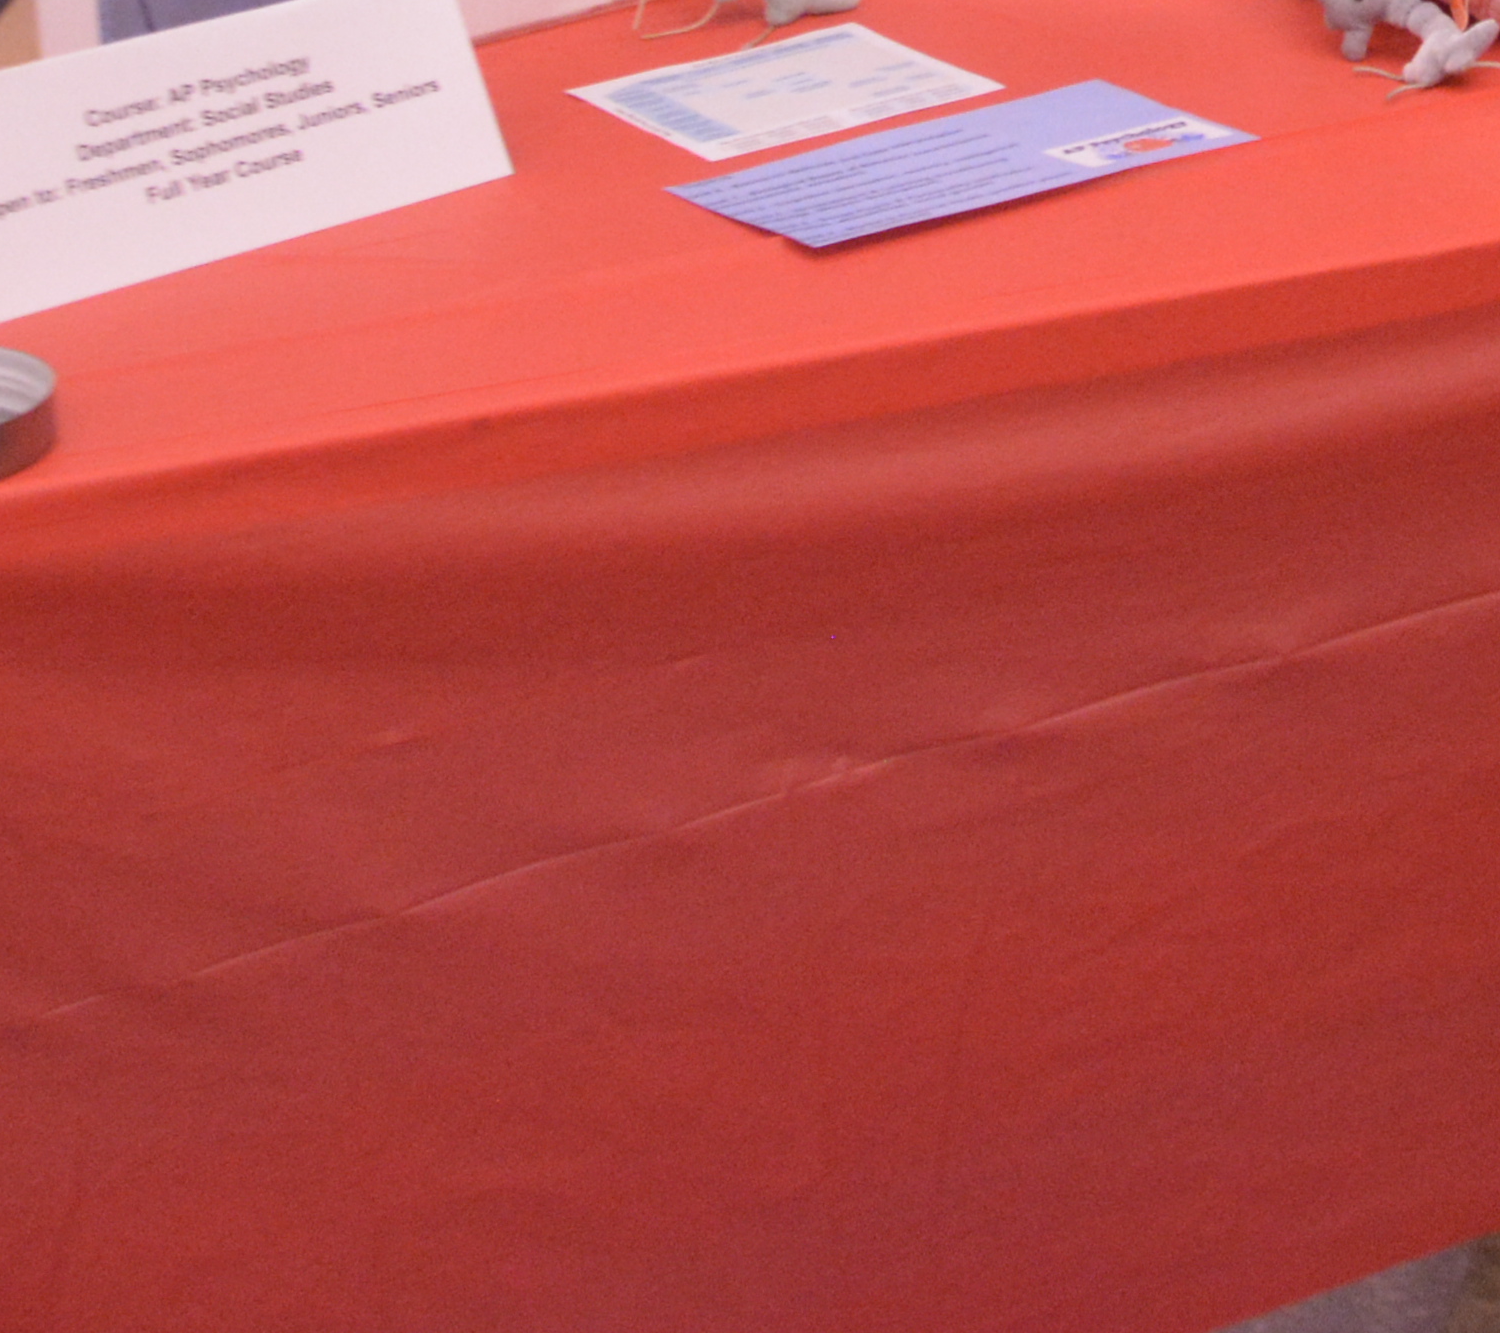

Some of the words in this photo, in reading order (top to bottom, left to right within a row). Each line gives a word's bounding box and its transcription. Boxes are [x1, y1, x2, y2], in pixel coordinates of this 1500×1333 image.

[77, 118, 195, 161] Department:
[201, 98, 260, 127] Social
[264, 79, 335, 109] Studies
[84, 97, 161, 127] Course:
[167, 84, 194, 105] AP
[200, 56, 310, 96] Psychology
[371, 78, 441, 109] Seniors
[144, 181, 185, 203] Full
[187, 168, 231, 193] Year
[234, 148, 305, 178] Course
